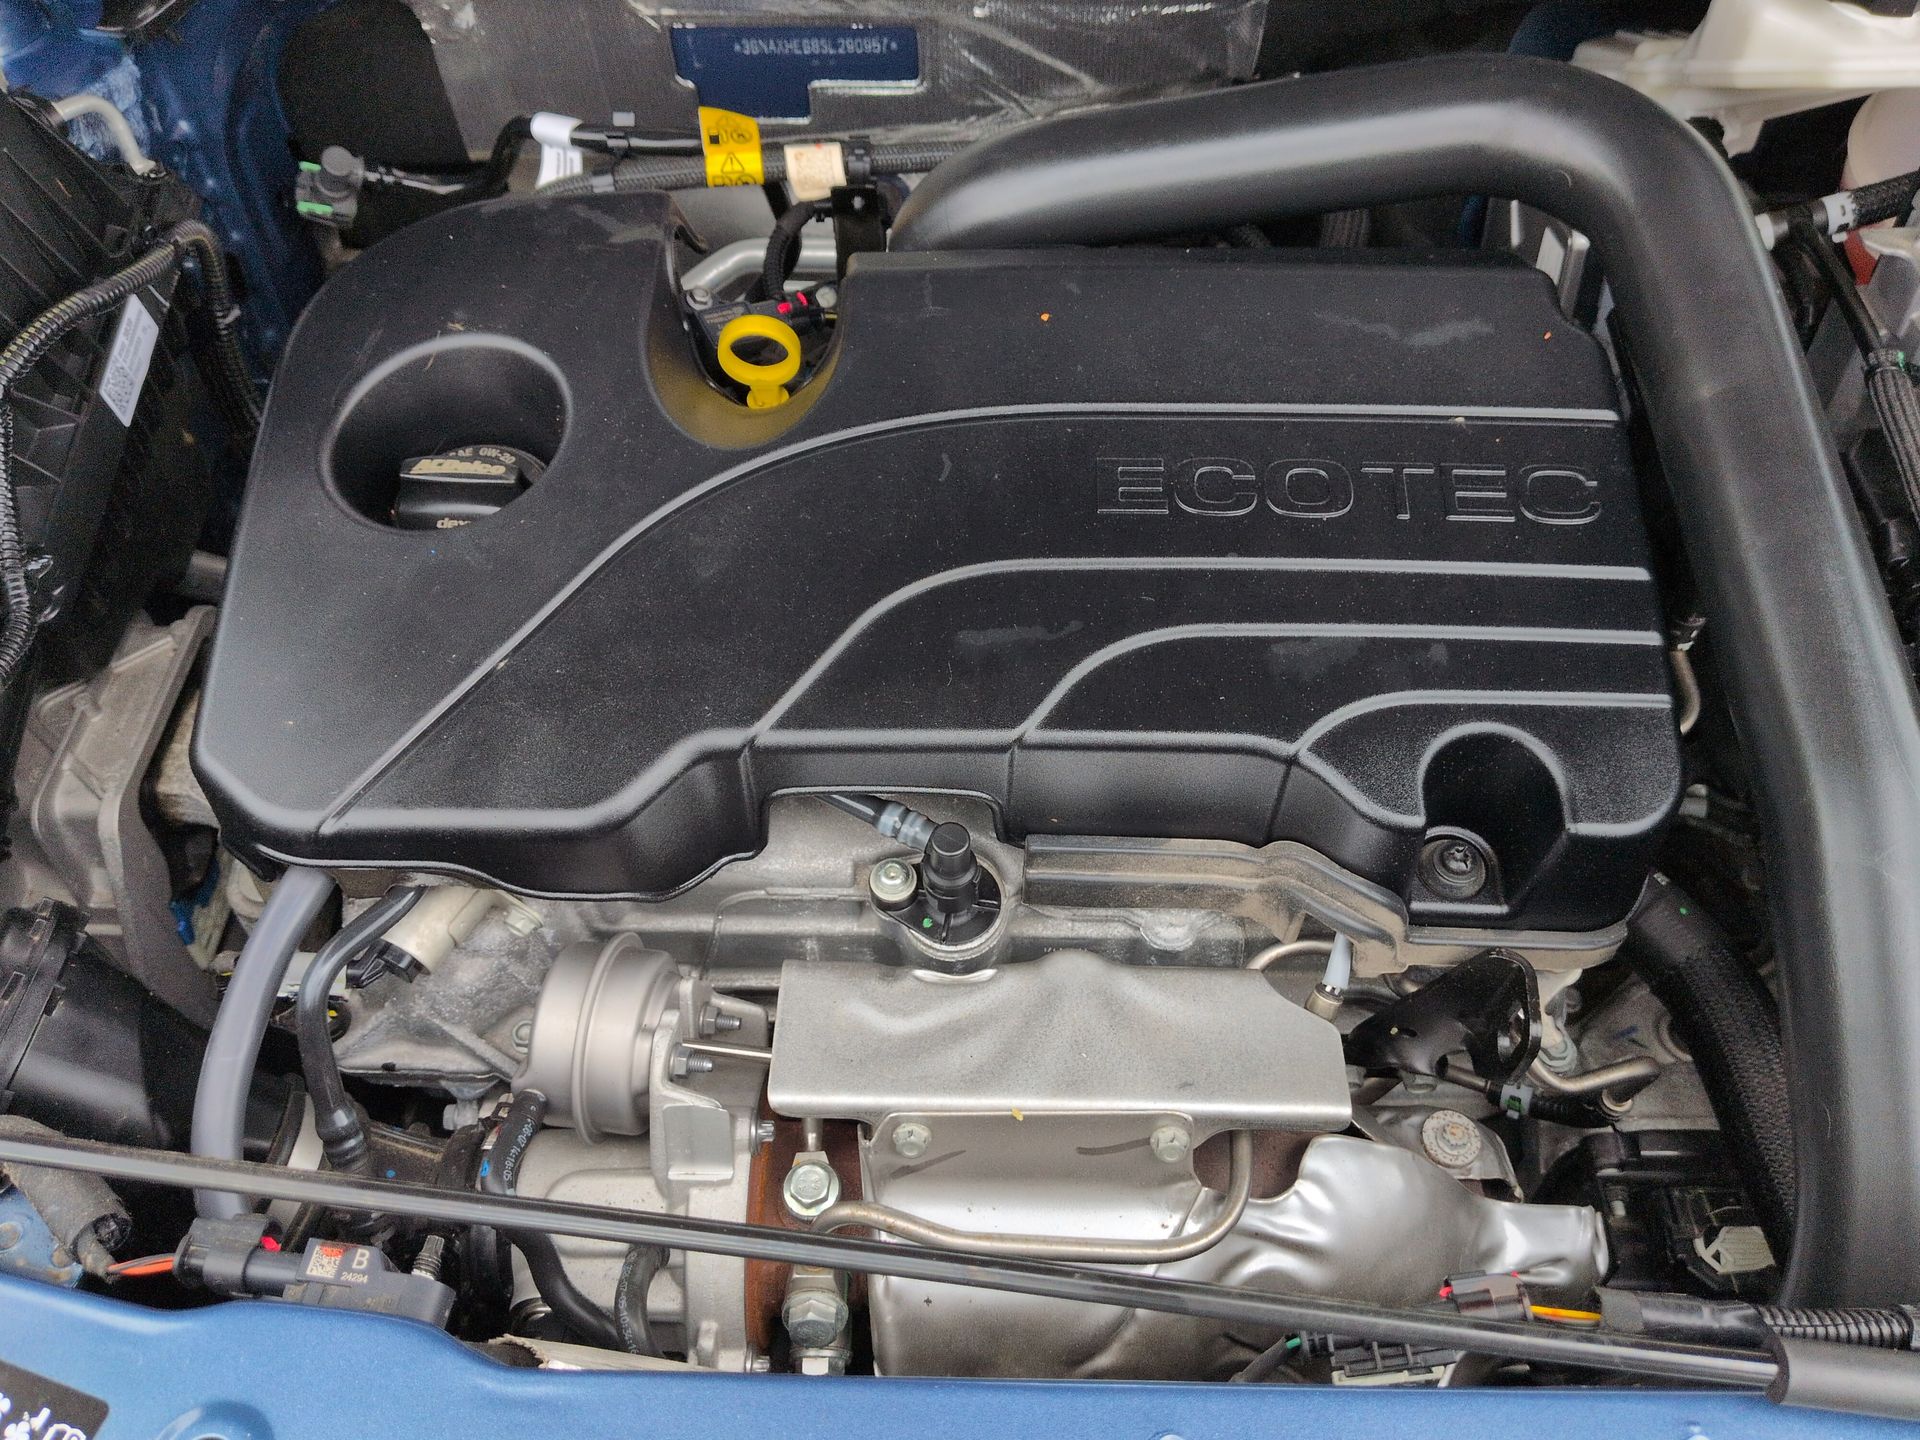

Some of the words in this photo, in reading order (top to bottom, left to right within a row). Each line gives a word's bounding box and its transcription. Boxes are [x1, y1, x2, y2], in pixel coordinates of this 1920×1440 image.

[1097, 457, 1601, 524] ECOTEC
[352, 1248, 370, 1269] B
[341, 1271, 369, 1283] 24294
